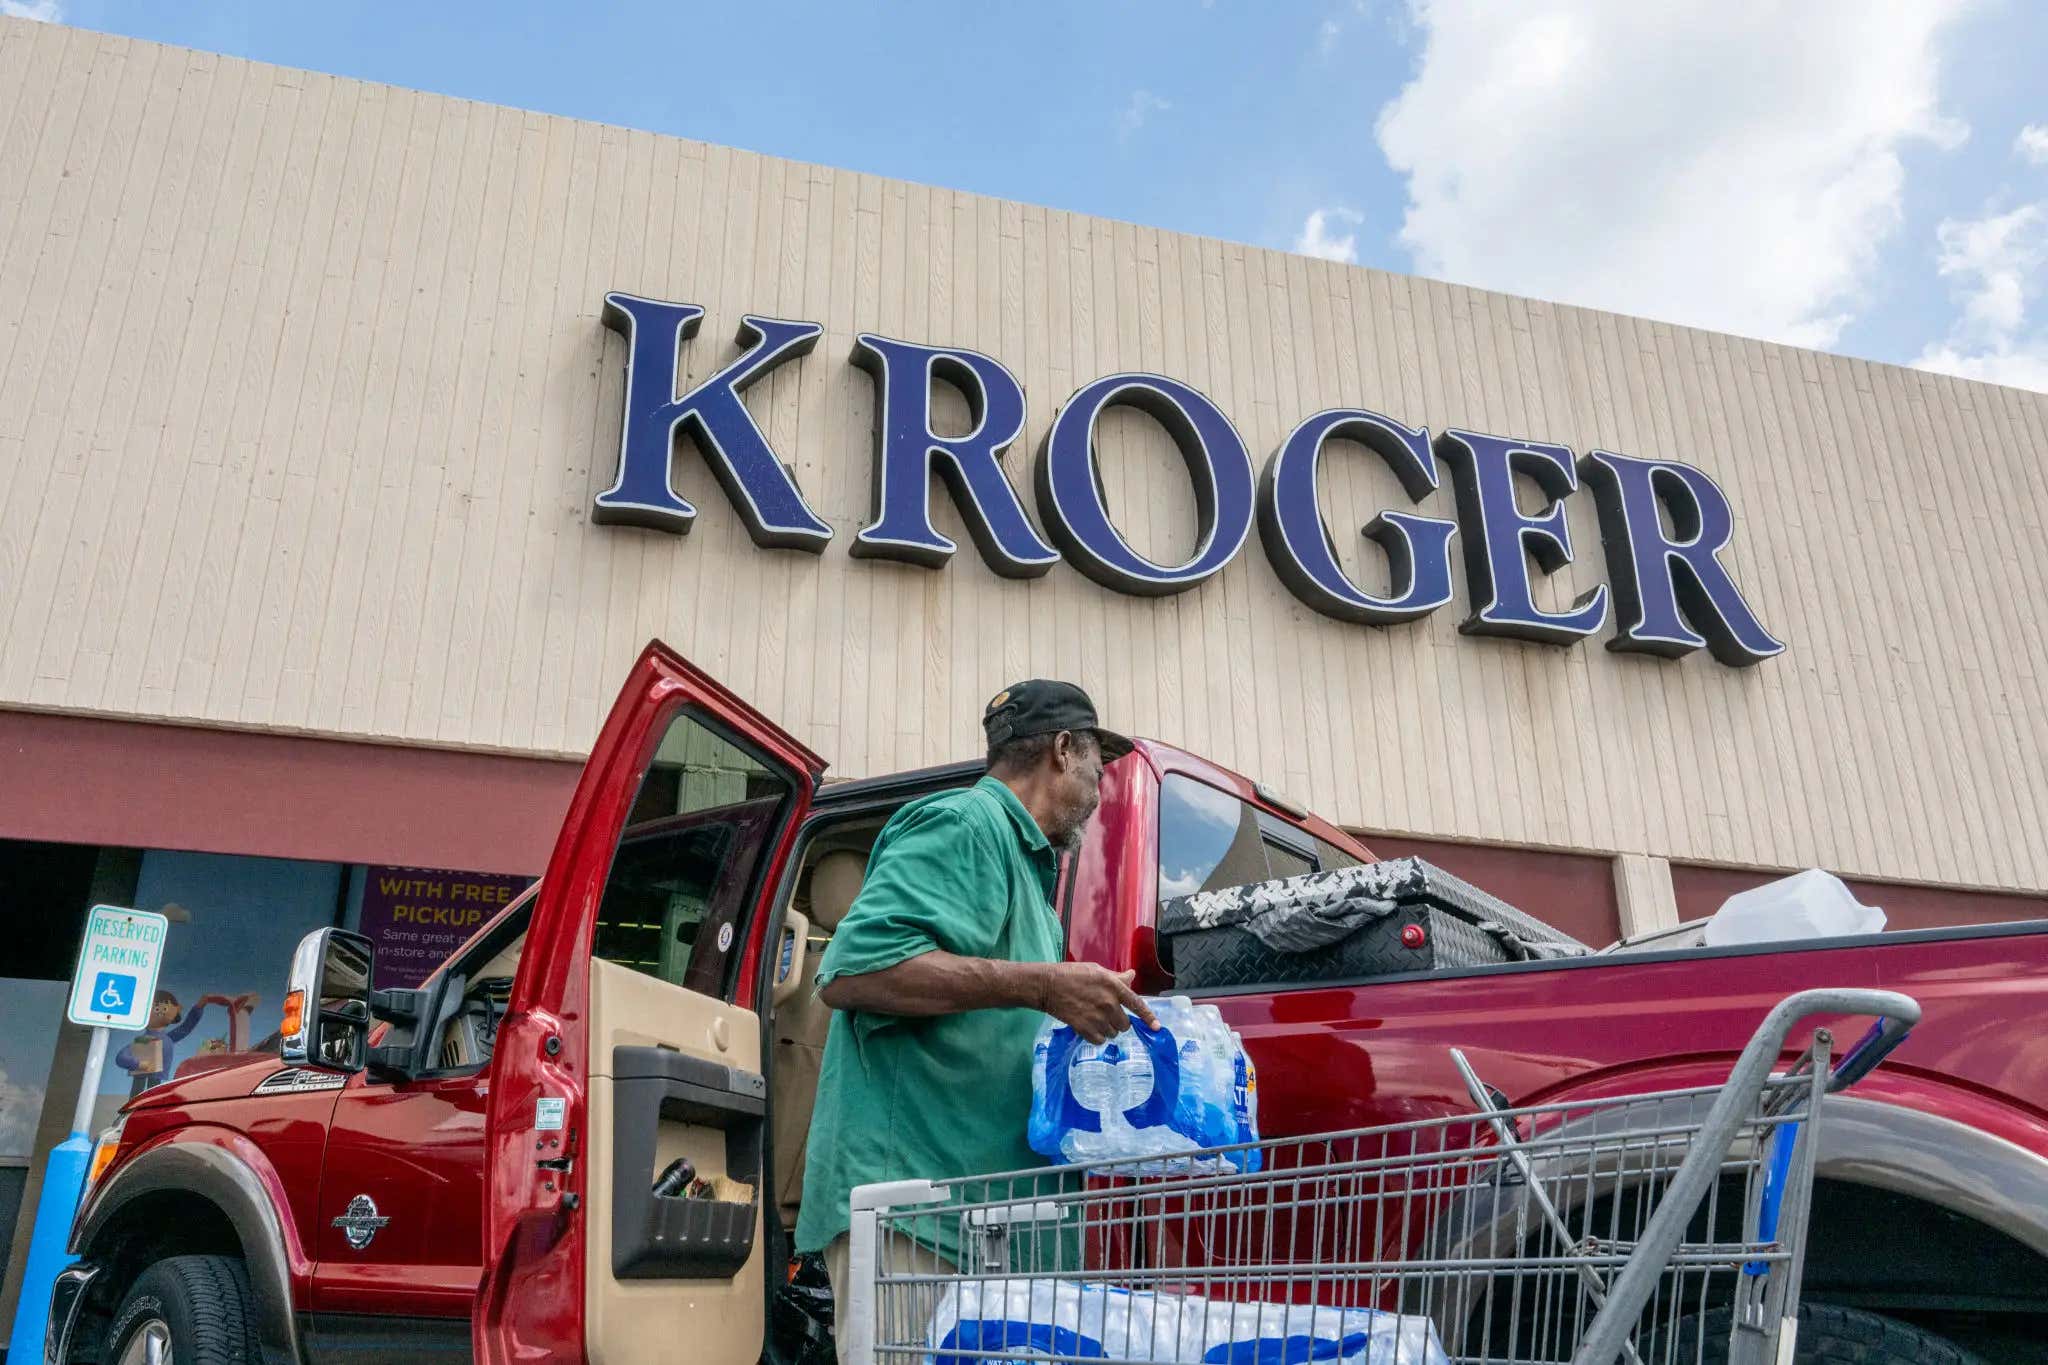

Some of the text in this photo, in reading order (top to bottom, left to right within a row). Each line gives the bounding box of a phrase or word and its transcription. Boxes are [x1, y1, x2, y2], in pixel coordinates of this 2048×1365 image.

[593, 291, 1785, 666] KROGER
[379, 877, 512, 904] WITH FREE
[93, 917, 160, 943] RESERVED
[383, 928, 418, 941] Same
[422, 931, 455, 944] great
[93, 944, 150, 968] PARKING
